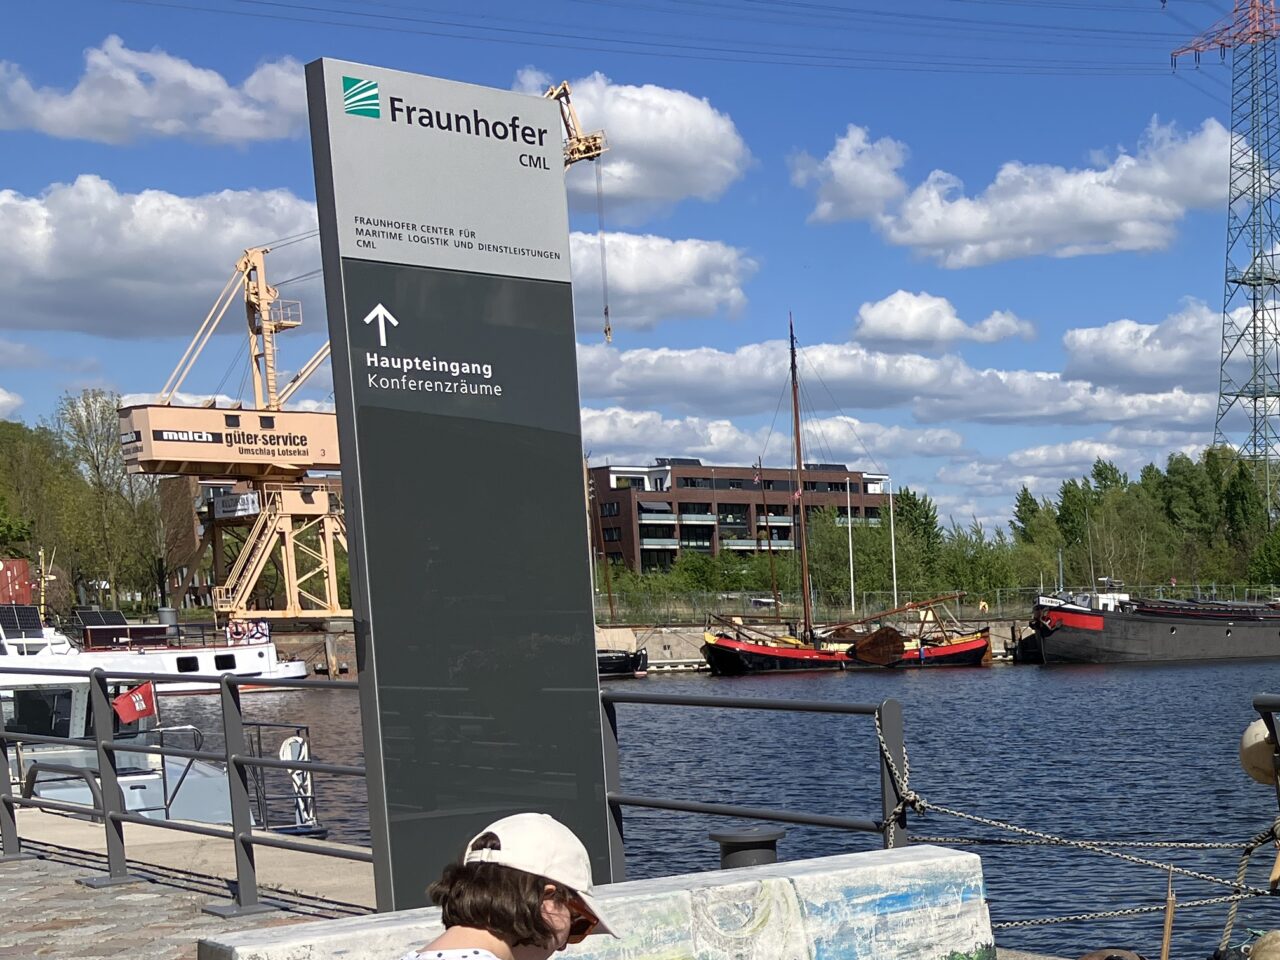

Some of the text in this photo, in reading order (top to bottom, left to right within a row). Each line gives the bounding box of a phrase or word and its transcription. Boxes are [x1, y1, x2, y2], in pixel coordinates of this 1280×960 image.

[389, 96, 548, 146] Fraunhofer
[519, 153, 550, 170] CML
[354, 216, 476, 239] FRAUNHOFER CENTER FÜR
[355, 228, 561, 260] MARITIME LOGISTIK UND DIENSTLEISTUNGEN
[356, 239, 376, 249] CML
[366, 352, 492, 378] Haupteingang
[368, 373, 502, 396] Konferenzräume
[162, 431, 308, 448] mulch güter-service
[238, 447, 276, 457] Umschlag
